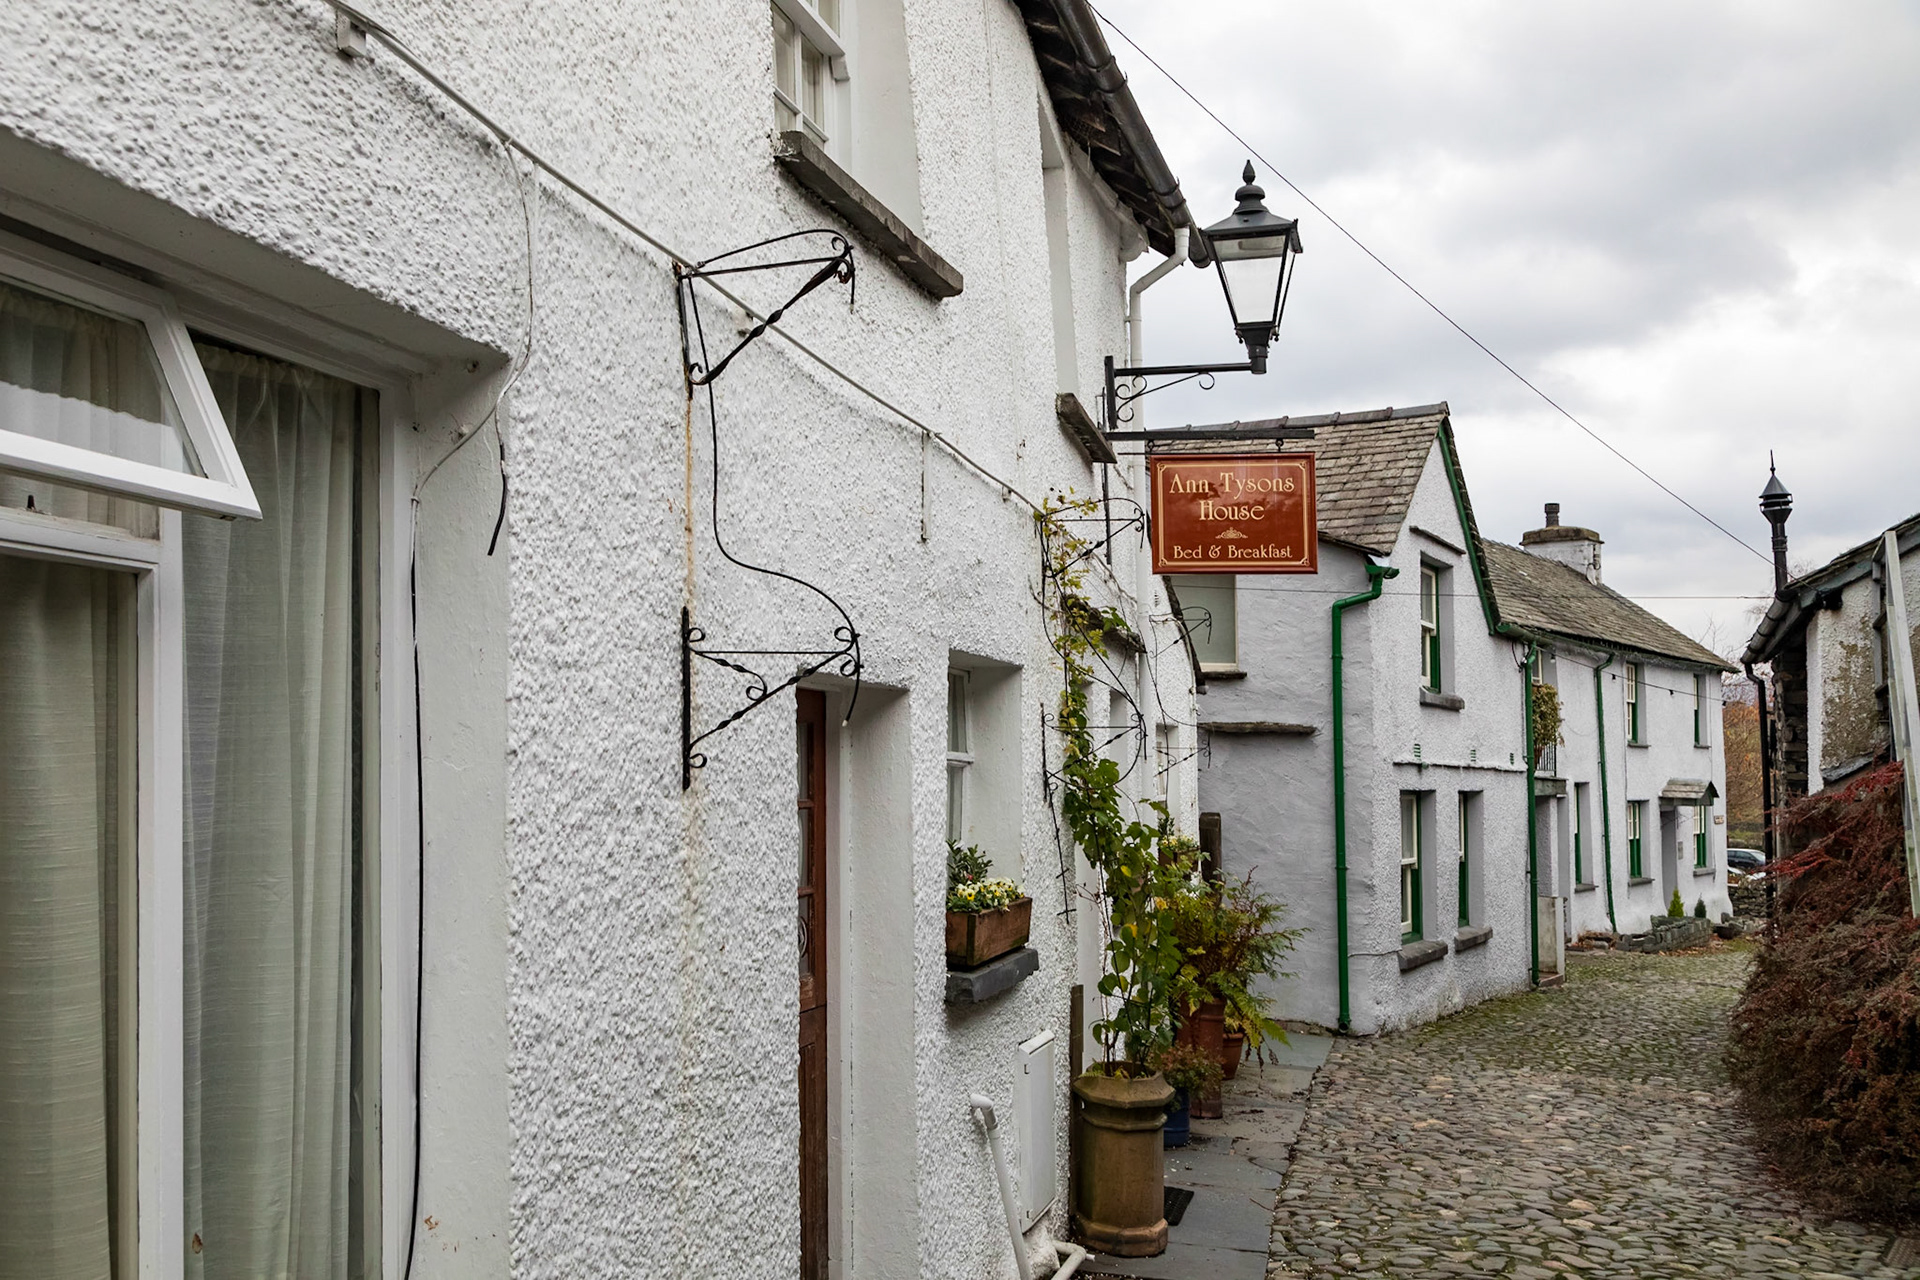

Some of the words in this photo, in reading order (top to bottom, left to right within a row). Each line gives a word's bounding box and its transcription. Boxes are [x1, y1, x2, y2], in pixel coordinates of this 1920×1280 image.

[1169, 473, 1209, 494] Ann
[1219, 472, 1295, 499] Tysons
[1199, 500, 1265, 521] House
[1173, 545, 1202, 559] Bed
[1208, 544, 1222, 559] &
[1228, 543, 1293, 559] Breakfast
